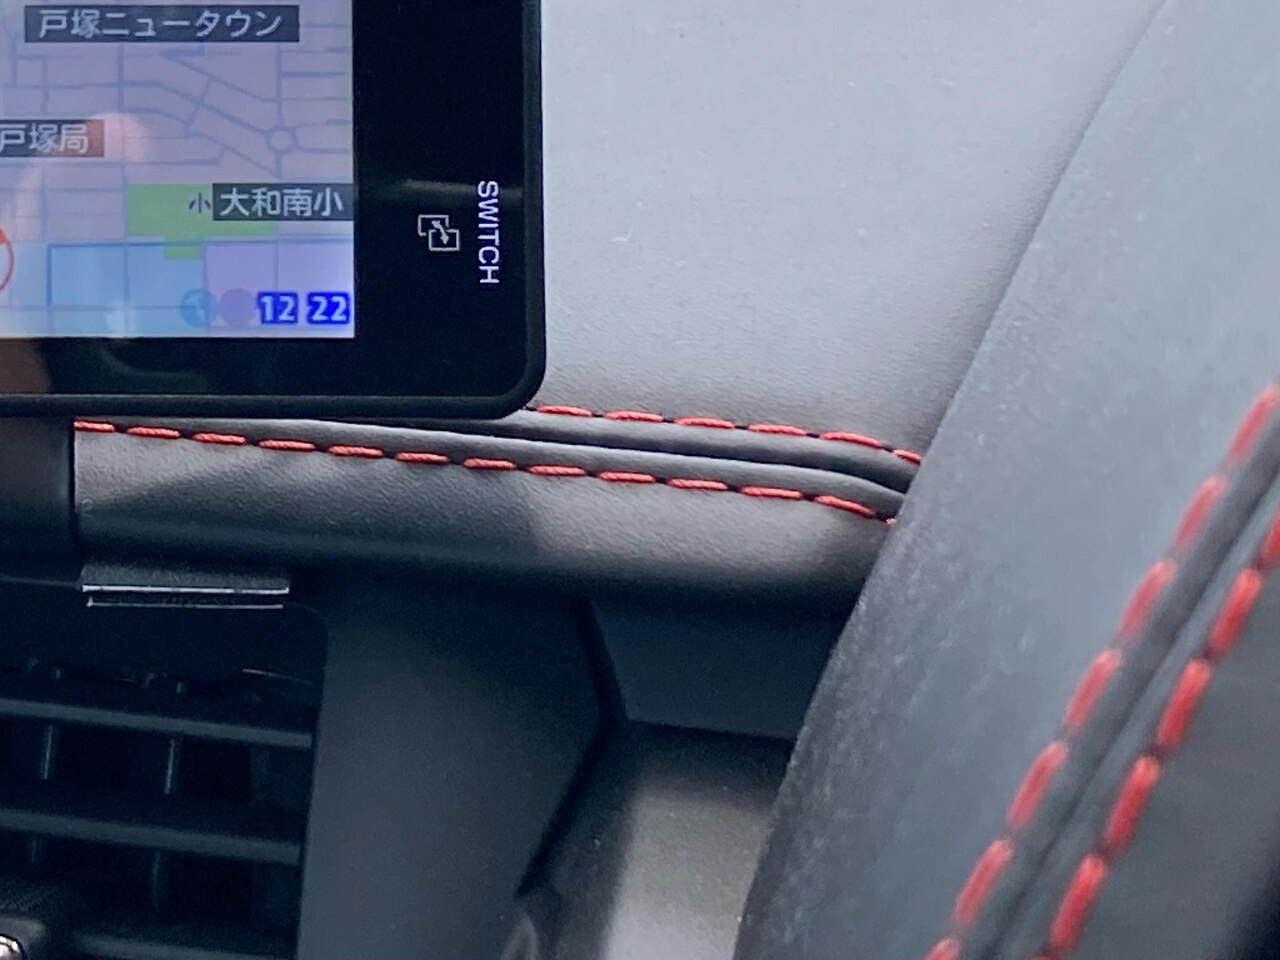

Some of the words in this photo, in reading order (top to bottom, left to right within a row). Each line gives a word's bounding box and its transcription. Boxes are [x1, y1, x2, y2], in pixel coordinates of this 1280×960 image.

[38, 8, 283, 39] 戸塚ニュータウン
[219, 187, 344, 218] 大和南小
[477, 179, 501, 284] SWITCH
